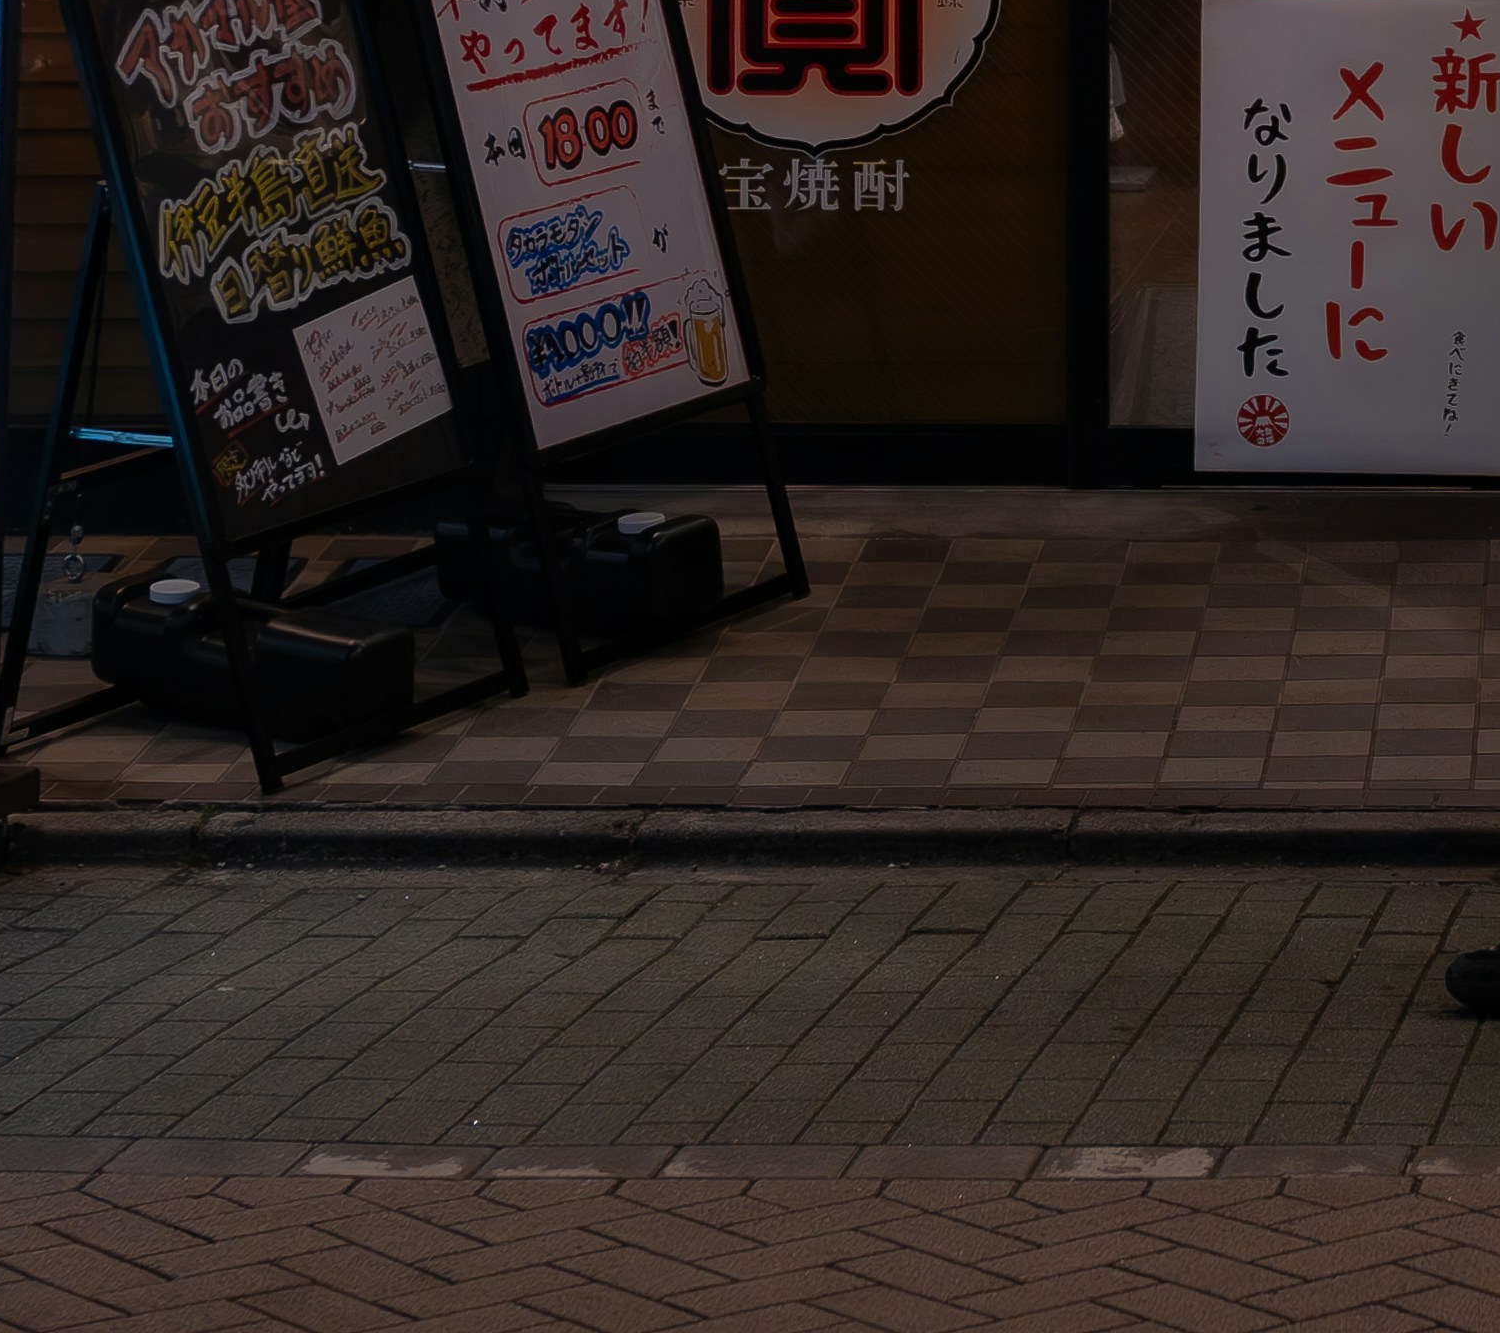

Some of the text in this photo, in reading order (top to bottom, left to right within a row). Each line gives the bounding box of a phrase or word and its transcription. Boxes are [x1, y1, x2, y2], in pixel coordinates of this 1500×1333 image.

[185, 40, 354, 153] おすすめ
[483, 126, 528, 167] 本日
[644, 89, 668, 136] まで
[160, 124, 386, 283] 伊豆半島直送
[718, 158, 911, 212] 宝焼酎
[1325, 60, 1399, 364] メニューに
[211, 198, 411, 322] 日替り鮮魚
[652, 223, 670, 254] が
[1236, 97, 1294, 379] なりました
[189, 357, 244, 406] 本日の
[212, 370, 290, 430] お品書き
